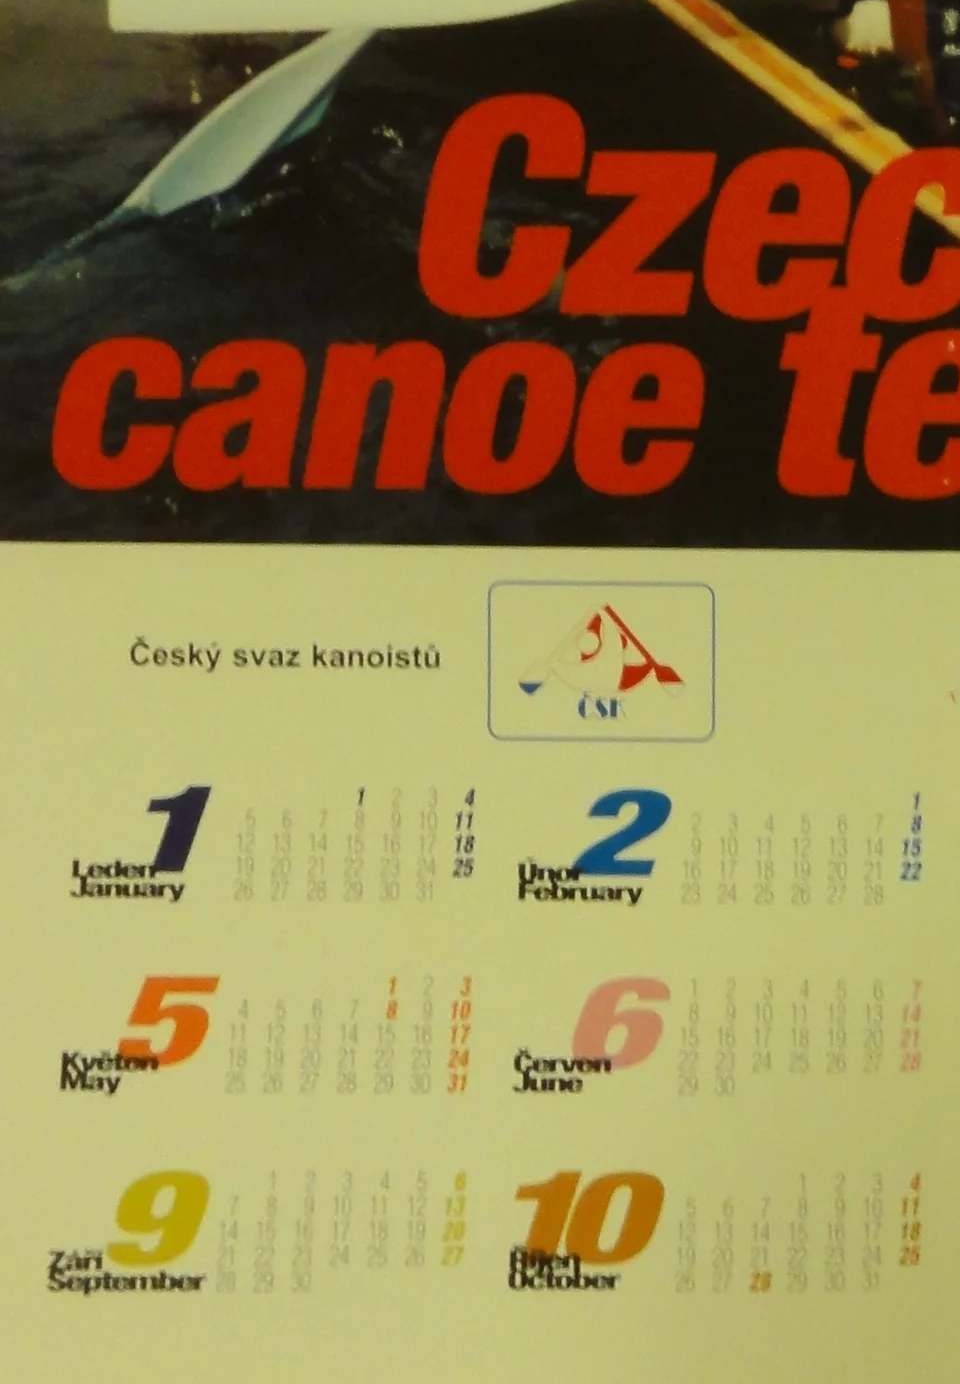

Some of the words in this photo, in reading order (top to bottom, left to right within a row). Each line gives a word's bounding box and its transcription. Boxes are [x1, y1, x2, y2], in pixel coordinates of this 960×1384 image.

[53, 337, 704, 495] canoe
[129, 635, 221, 673] Český
[232, 646, 300, 667] svaz
[312, 643, 441, 669] kanoistů
[464, 786, 476, 808] 4
[146, 785, 212, 872] 1
[456, 809, 474, 831] 11
[910, 813, 923, 835] 8
[571, 789, 673, 876] 2
[455, 833, 476, 855] 18
[902, 837, 922, 859] 15
[72, 859, 157, 880] Leden
[452, 857, 475, 879] 25
[899, 860, 923, 882] 22
[70, 878, 184, 903] January
[517, 880, 642, 905] February
[459, 975, 473, 997] 3
[117, 974, 221, 1068] 5
[385, 999, 399, 1021] 8
[451, 999, 472, 1021] 10
[571, 976, 671, 1069] 6
[450, 1024, 472, 1046] 17
[447, 1048, 470, 1070] 24
[59, 1070, 120, 1096] May
[446, 1073, 468, 1095] 31
[513, 1071, 583, 1094] June
[106, 1169, 210, 1267] 9
[515, 1169, 666, 1267] 10
[46, 1270, 205, 1297] September
[508, 1270, 621, 1290] October
